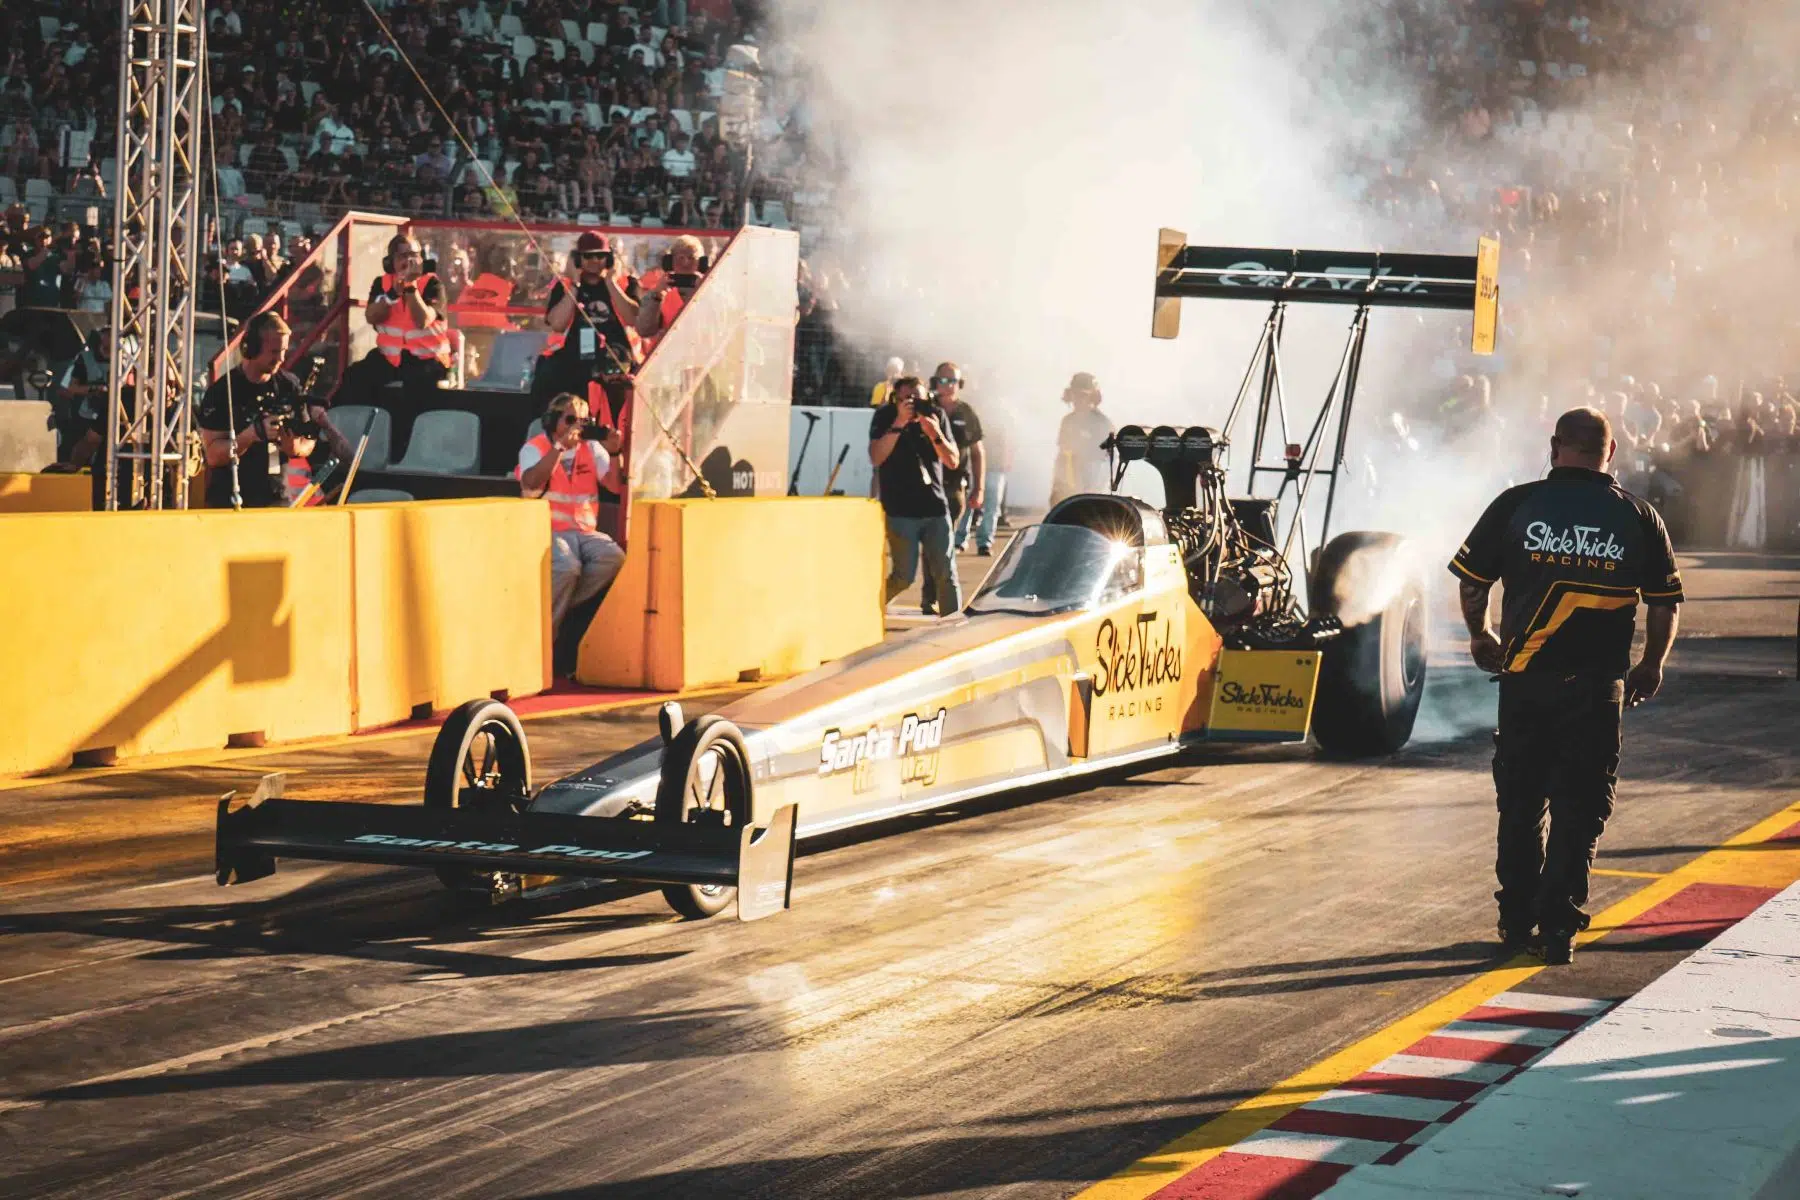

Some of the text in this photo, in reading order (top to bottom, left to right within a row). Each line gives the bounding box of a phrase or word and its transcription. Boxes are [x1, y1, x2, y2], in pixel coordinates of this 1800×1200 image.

[1524, 521, 1574, 554] Slick
[1531, 553, 1616, 571] RACING
[1093, 611, 1181, 697] Slick Tricks
[1108, 696, 1163, 720] RACING
[1220, 681, 1304, 708] Slick Tricks
[818, 706, 947, 775] Santa Pod
[345, 834, 520, 852] Santa
[528, 844, 654, 860] Pod
